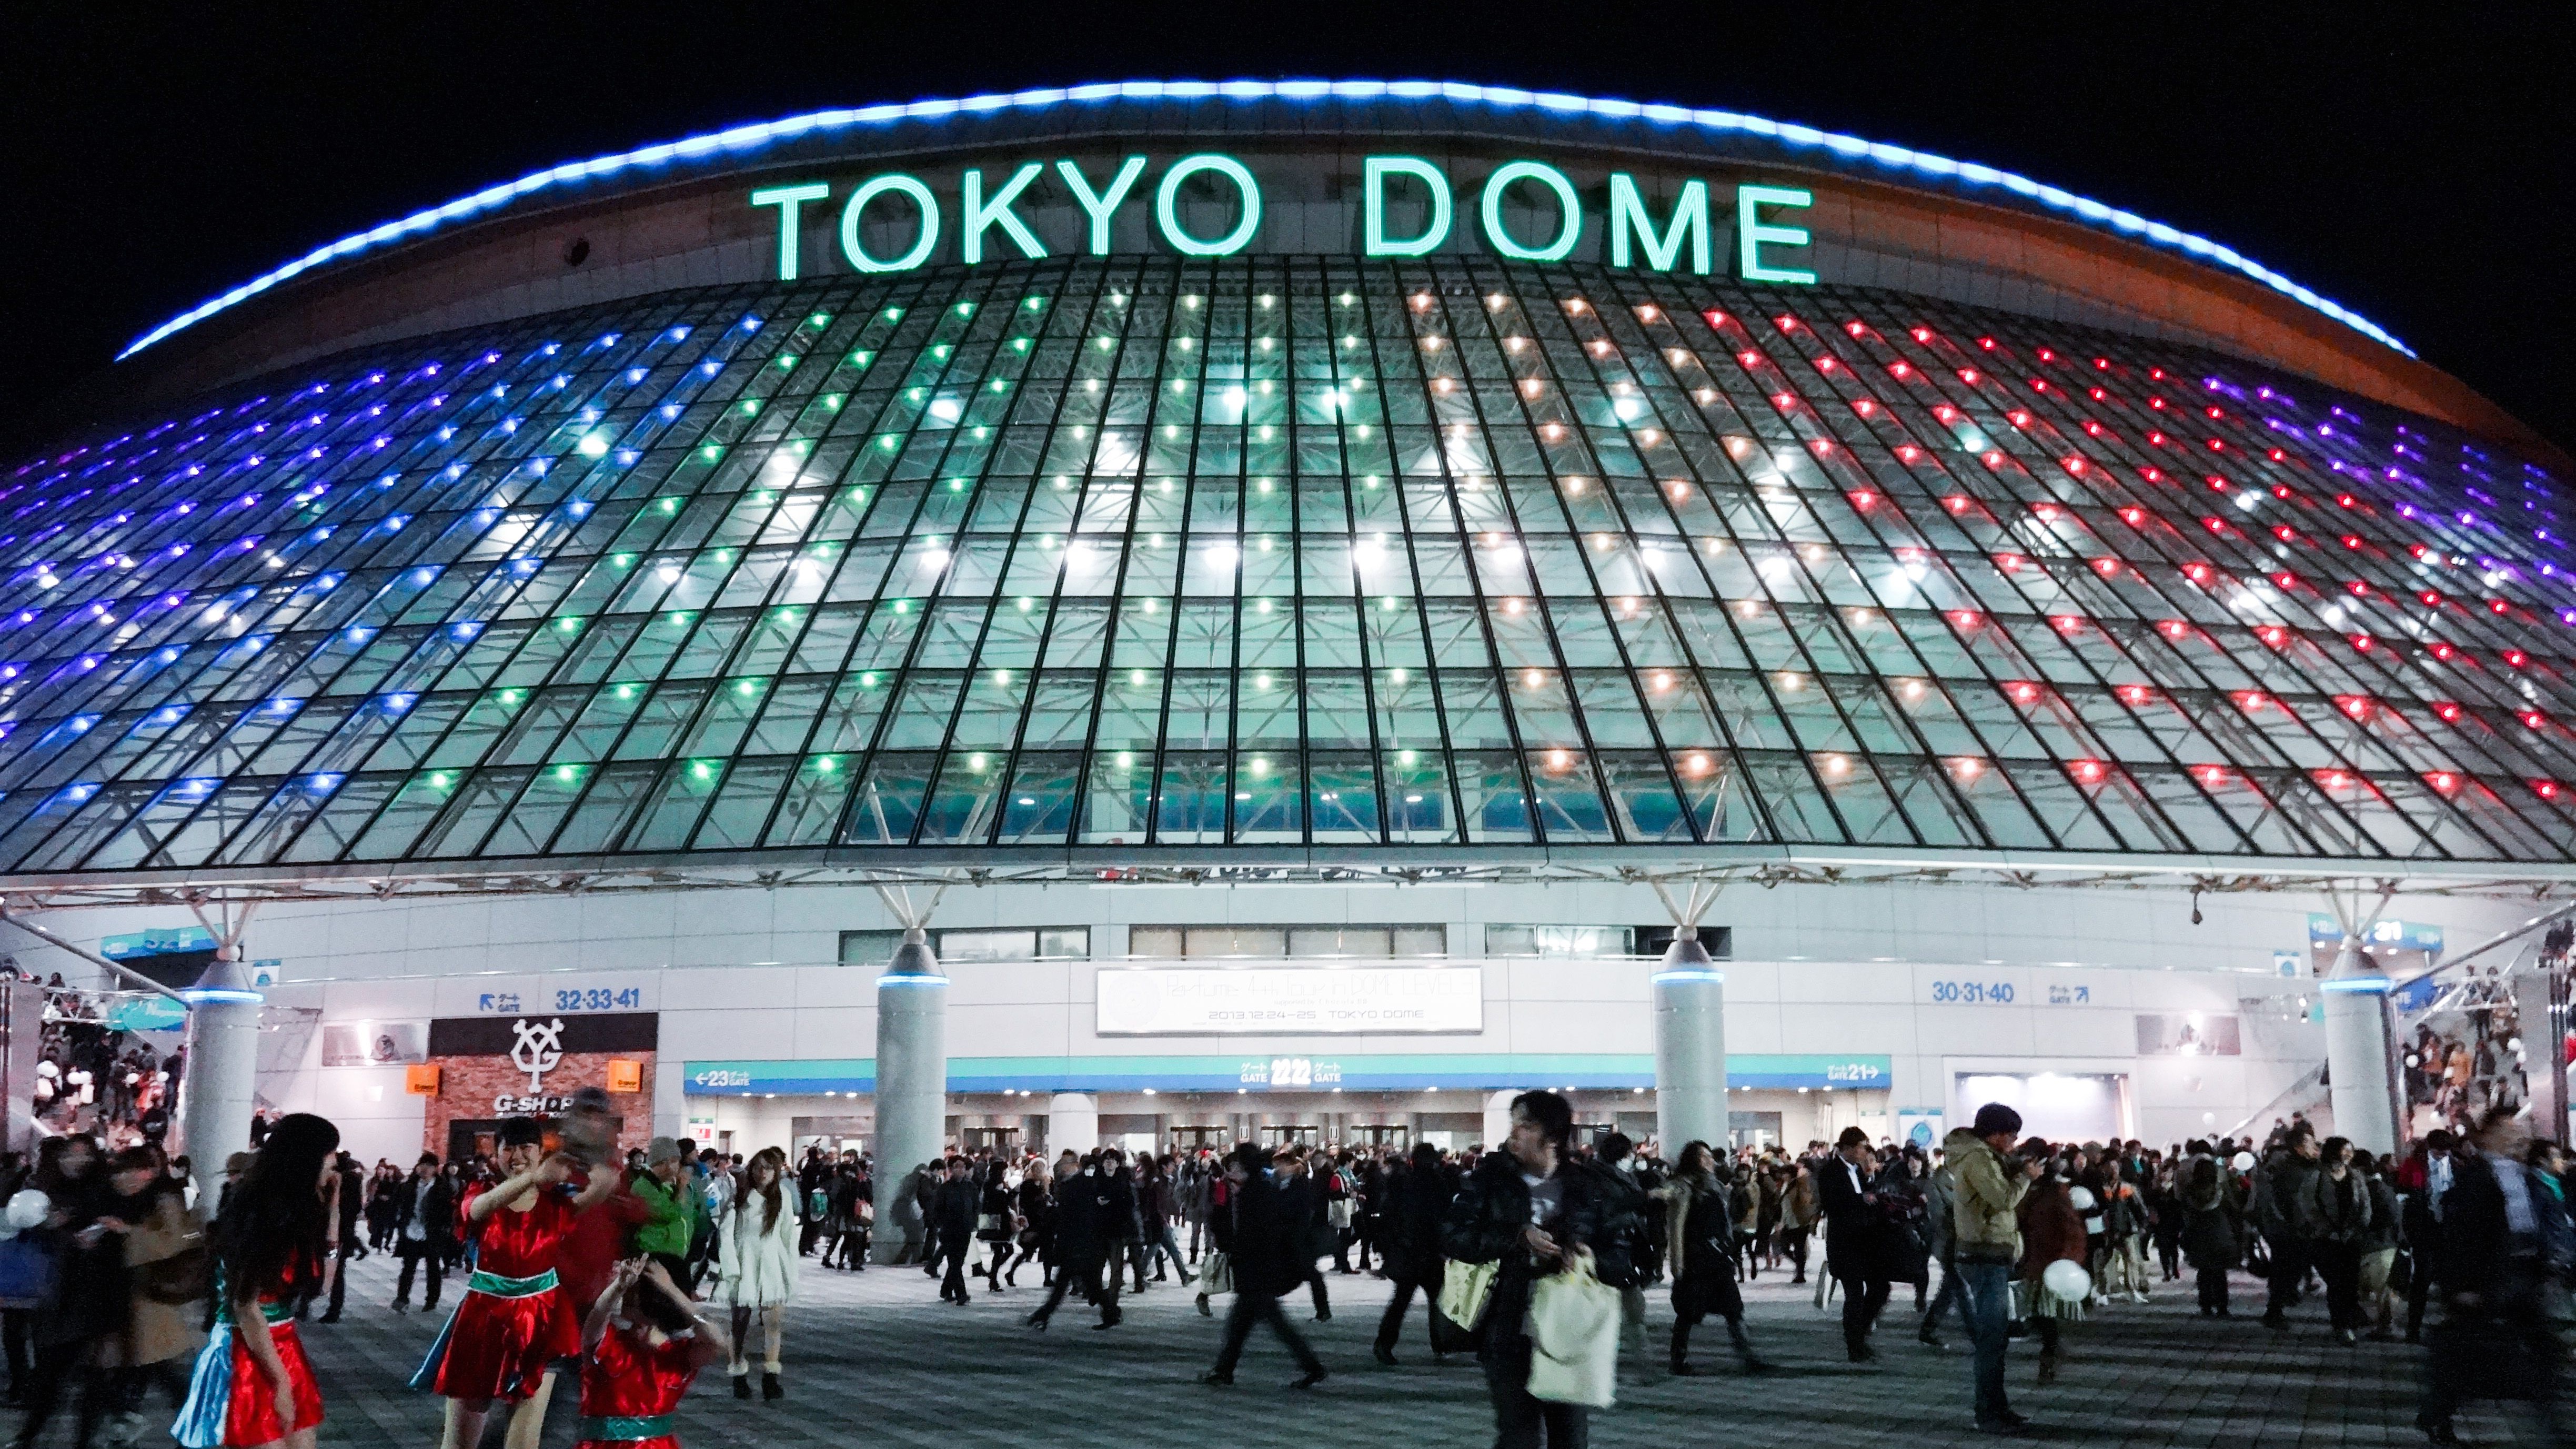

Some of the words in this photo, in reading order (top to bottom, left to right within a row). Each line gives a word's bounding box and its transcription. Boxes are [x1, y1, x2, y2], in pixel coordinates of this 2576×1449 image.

[752, 157, 1260, 280] TOKYO
[1366, 158, 1816, 284] DOME
[2374, 921, 2402, 941] 31
[1166, 974, 1239, 996] Perfume
[1329, 1011, 1377, 1019] TOKYO
[1383, 1010, 1424, 1019] DOME
[1241, 1062, 1267, 1072] ゲート
[1314, 1062, 1341, 1072] ゲート
[1848, 1063, 1867, 1081] 21
[708, 1070, 729, 1086] 23
[1241, 1073, 1267, 1083] GATE
[1314, 1073, 1342, 1082] GATE
[494, 1094, 575, 1112] G-SHOP
